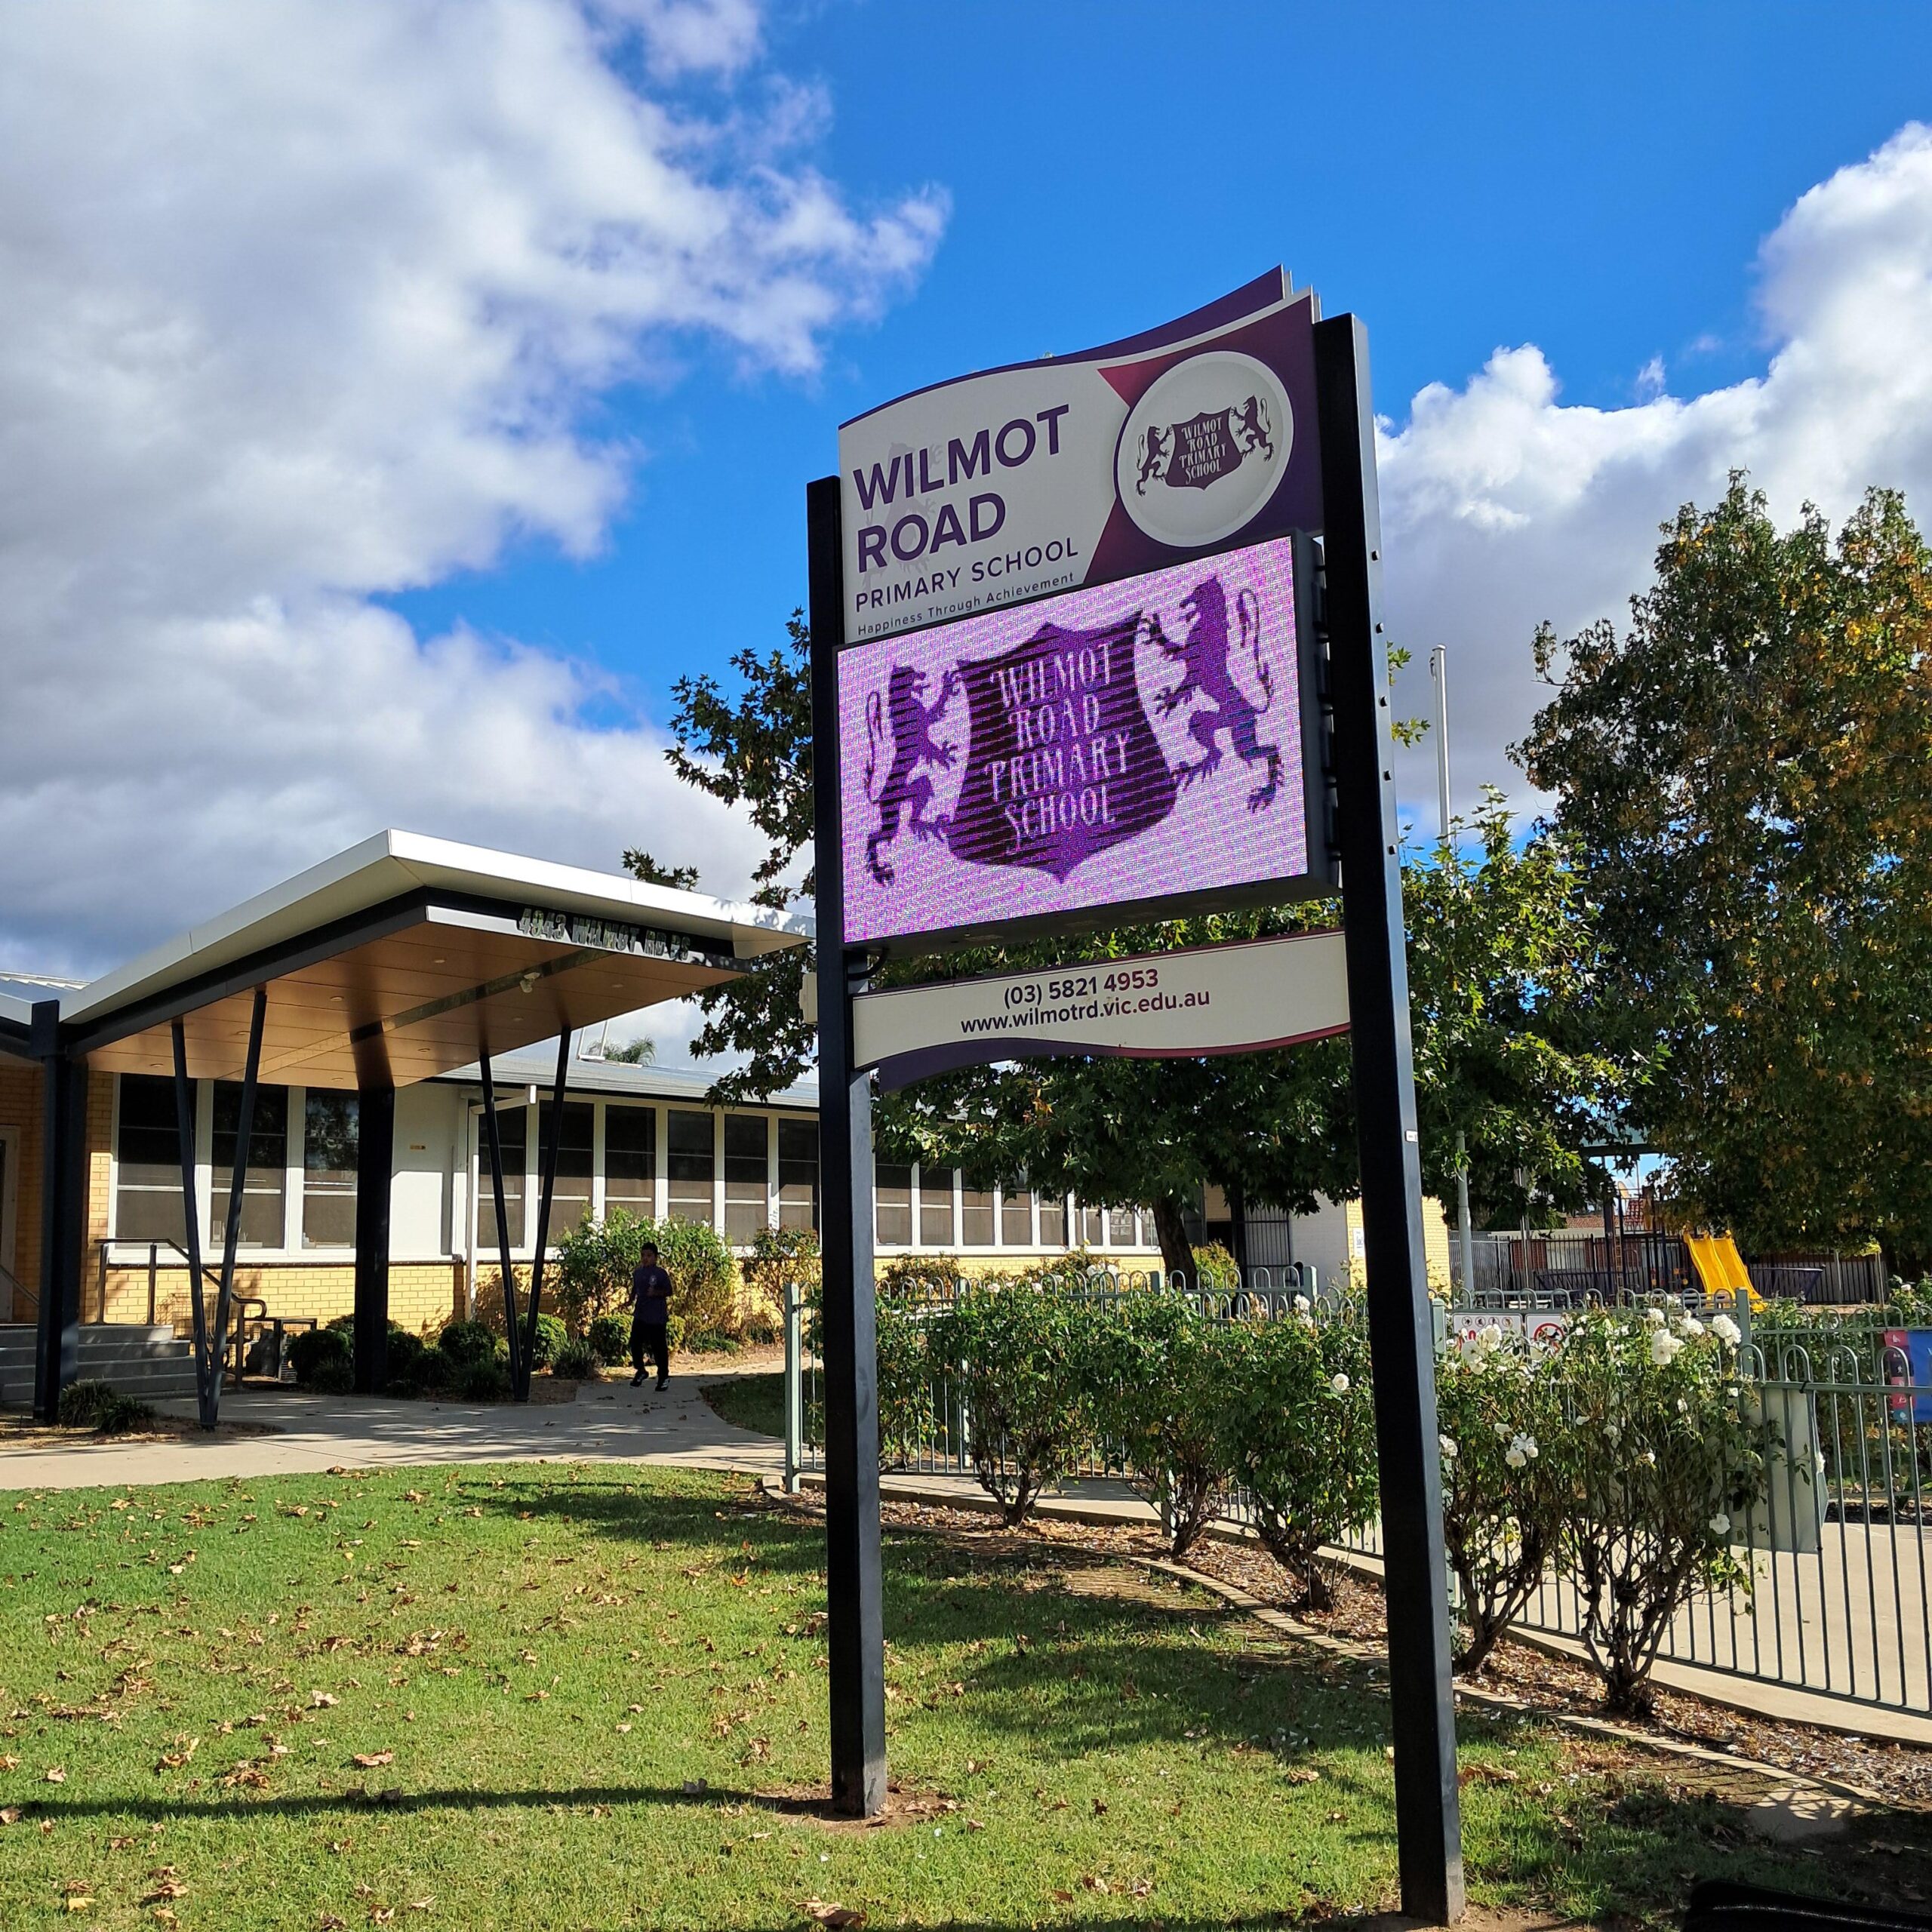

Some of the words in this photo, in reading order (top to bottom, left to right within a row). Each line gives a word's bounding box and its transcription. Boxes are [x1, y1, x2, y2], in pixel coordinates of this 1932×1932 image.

[1179, 443, 1226, 468] PRIMARY
[1181, 417, 1222, 440] WILMOT
[1187, 432, 1217, 453] ROAD
[853, 403, 1069, 511] WILMOT
[1185, 459, 1222, 485] SCHOOL
[857, 492, 1006, 574] ROAD
[856, 567, 961, 613] PRIMARY
[971, 537, 1078, 583] SCHOOL
[857, 611, 923, 636] Happiness
[928, 595, 980, 619] Through
[986, 571, 1075, 603] Achievement
[990, 642, 1112, 708] WILMOT
[1008, 694, 1100, 749] ROAD
[984, 732, 1131, 802] PRIMARY
[1004, 784, 1116, 854] SCHOOL
[572, 915, 640, 953] WILMOT
[644, 929, 667, 957] RD
[961, 990, 1211, 1033] www.wilmotrd.vic.edu.au
[1004, 984, 1043, 1010] (03)
[1049, 976, 1098, 1000] 5821
[1103, 968, 1159, 992] 4953
